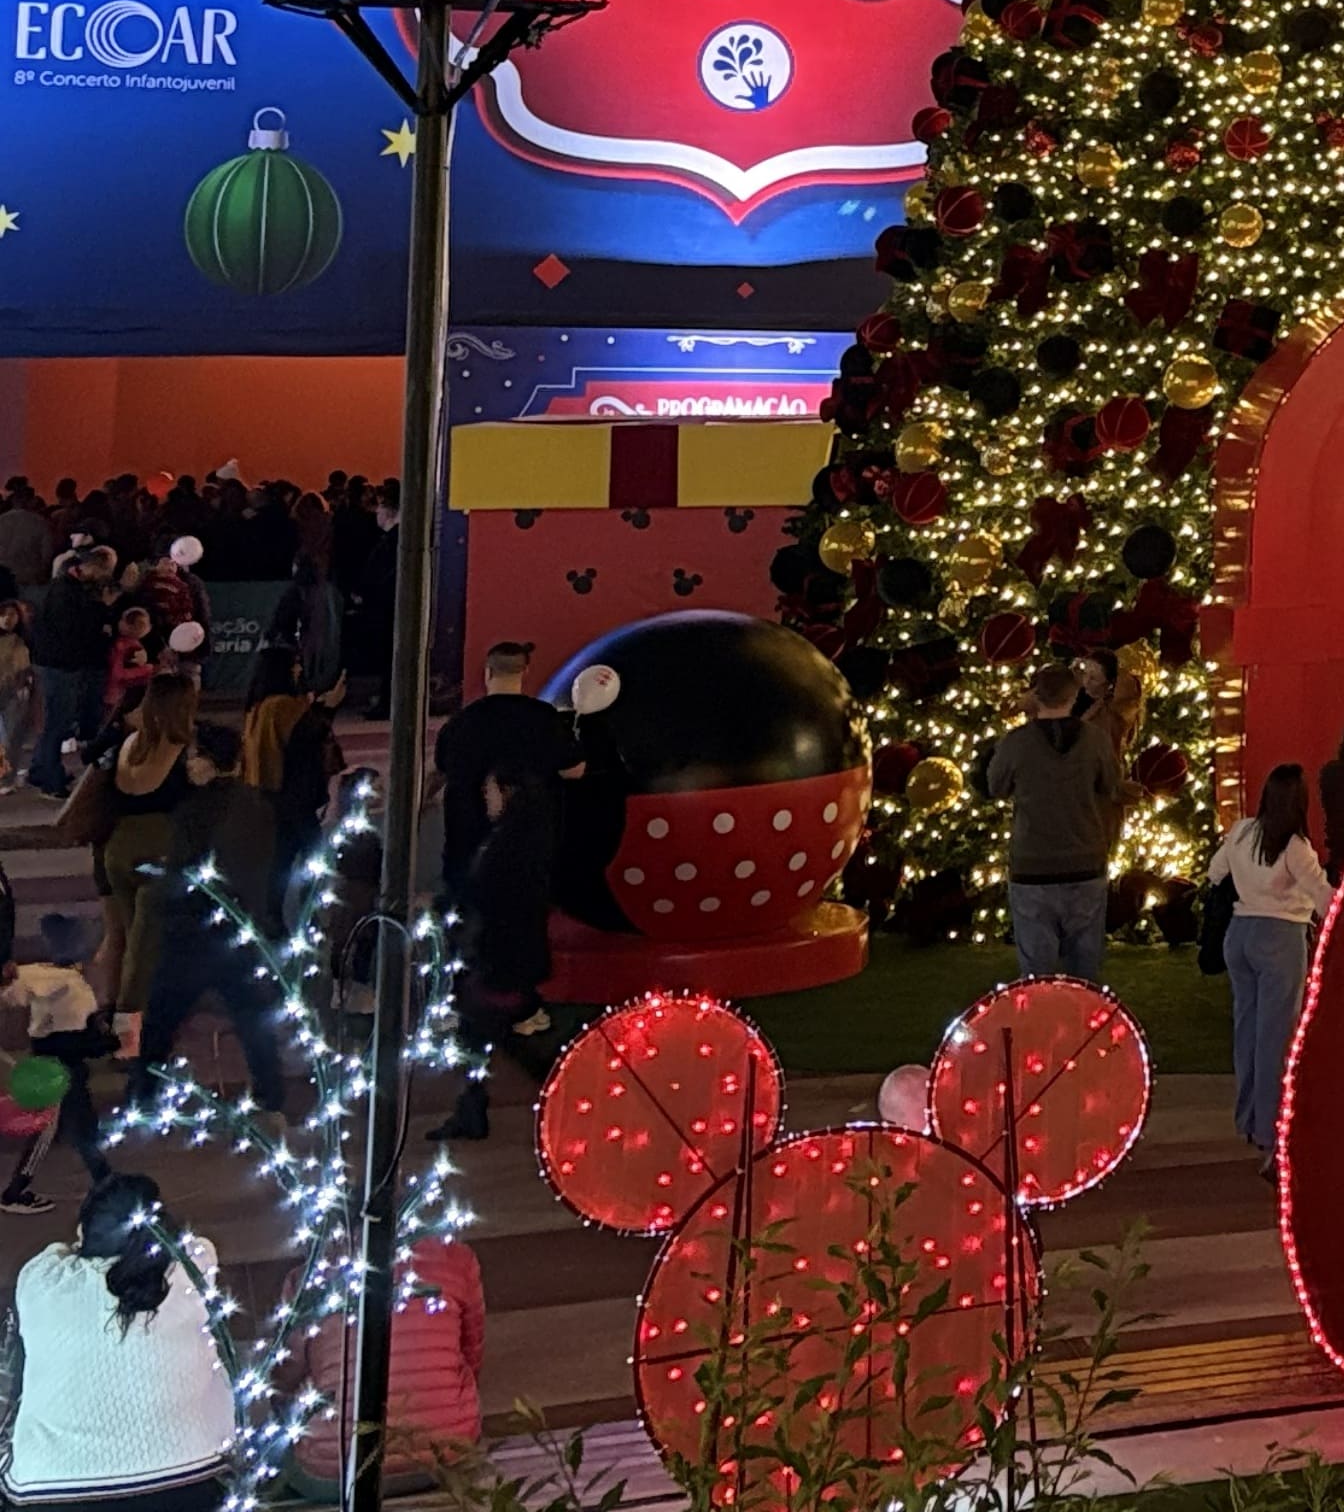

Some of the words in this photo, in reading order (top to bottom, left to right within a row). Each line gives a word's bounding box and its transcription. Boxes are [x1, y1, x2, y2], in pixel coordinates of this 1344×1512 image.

[16, 0, 237, 68] ECOAR
[39, 71, 121, 88] Concerto
[125, 73, 236, 92] Infantojuvenil
